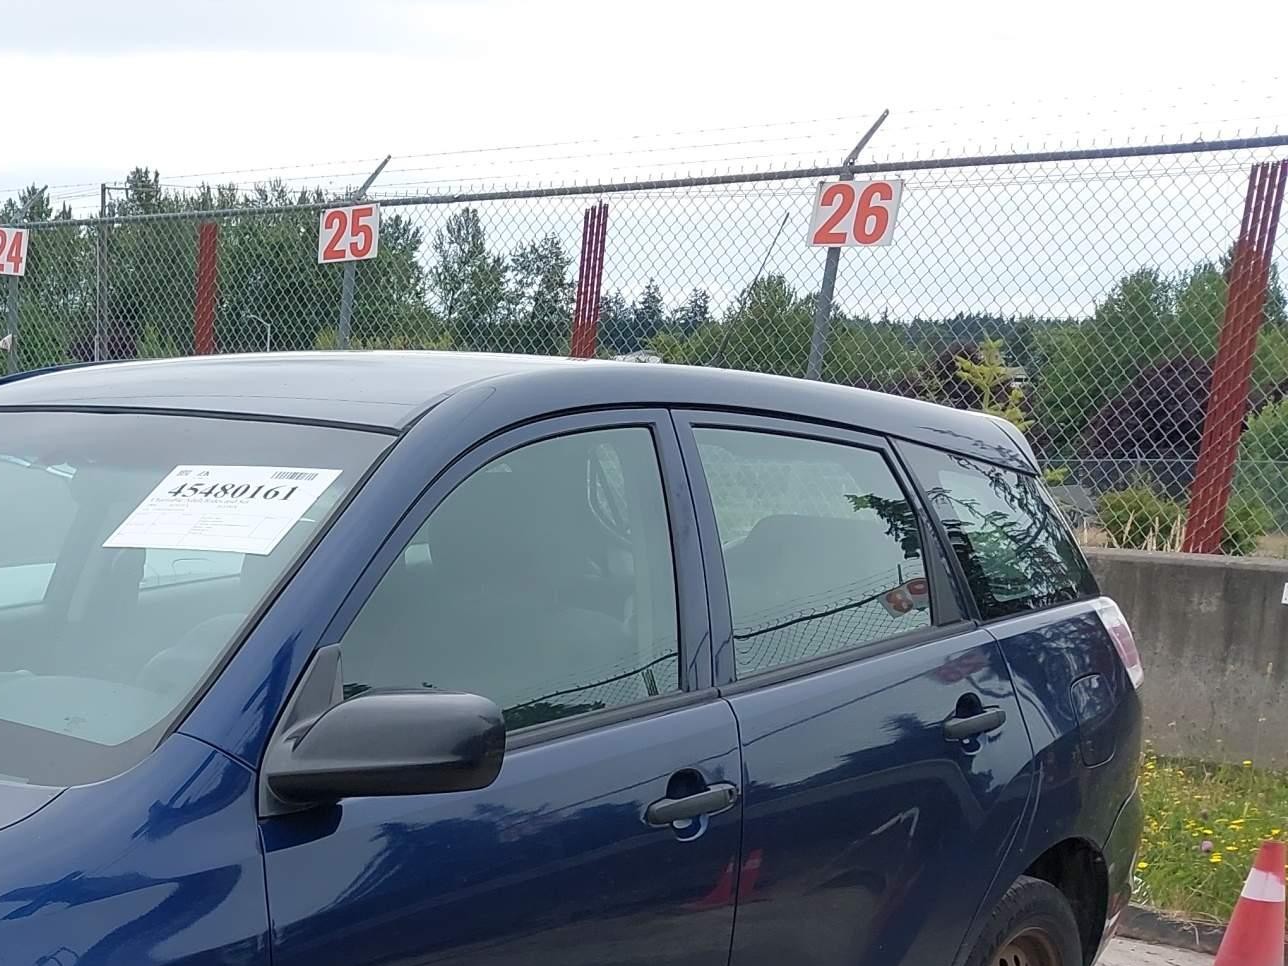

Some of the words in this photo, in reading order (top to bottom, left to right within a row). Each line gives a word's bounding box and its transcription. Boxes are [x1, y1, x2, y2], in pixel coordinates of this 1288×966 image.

[323, 207, 374, 261] 25
[812, 181, 894, 246] 26
[167, 482, 299, 501] 45480161
